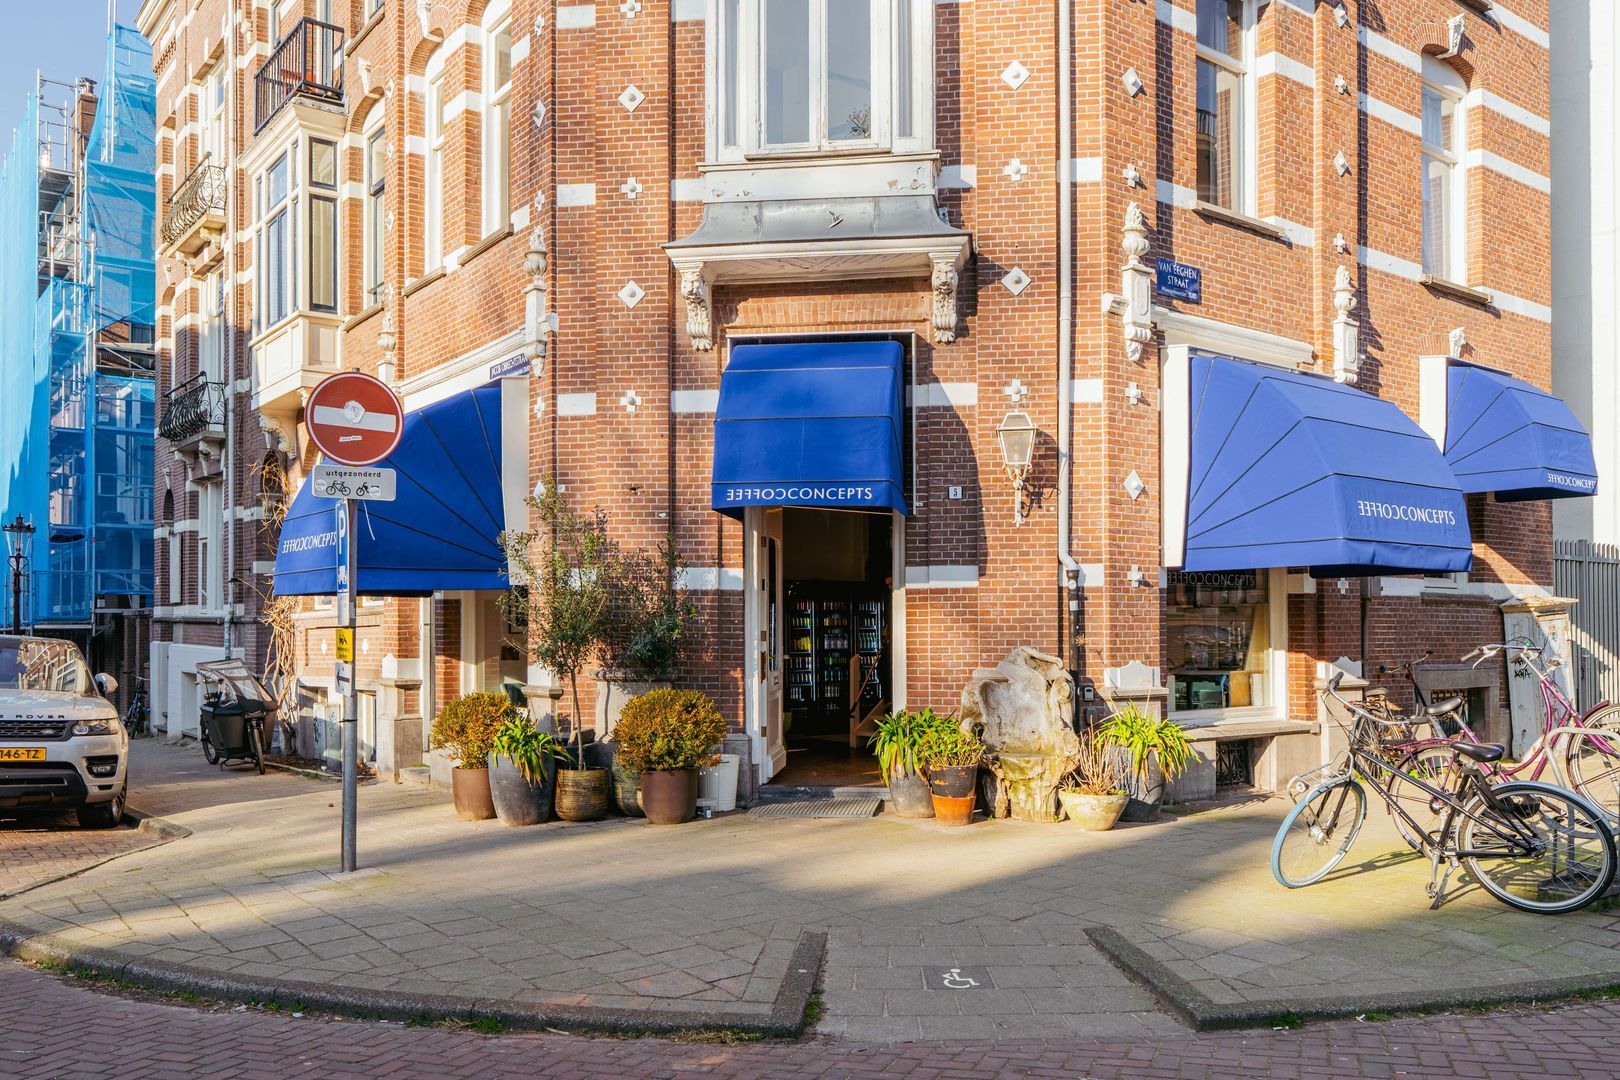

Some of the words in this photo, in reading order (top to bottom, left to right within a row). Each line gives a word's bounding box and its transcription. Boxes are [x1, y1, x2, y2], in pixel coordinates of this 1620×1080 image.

[1158, 261, 1172, 273] VAN
[1173, 264, 1197, 280] EEGHEN
[1167, 275, 1189, 289] STRAAT
[325, 470, 381, 478] uitgezonderd
